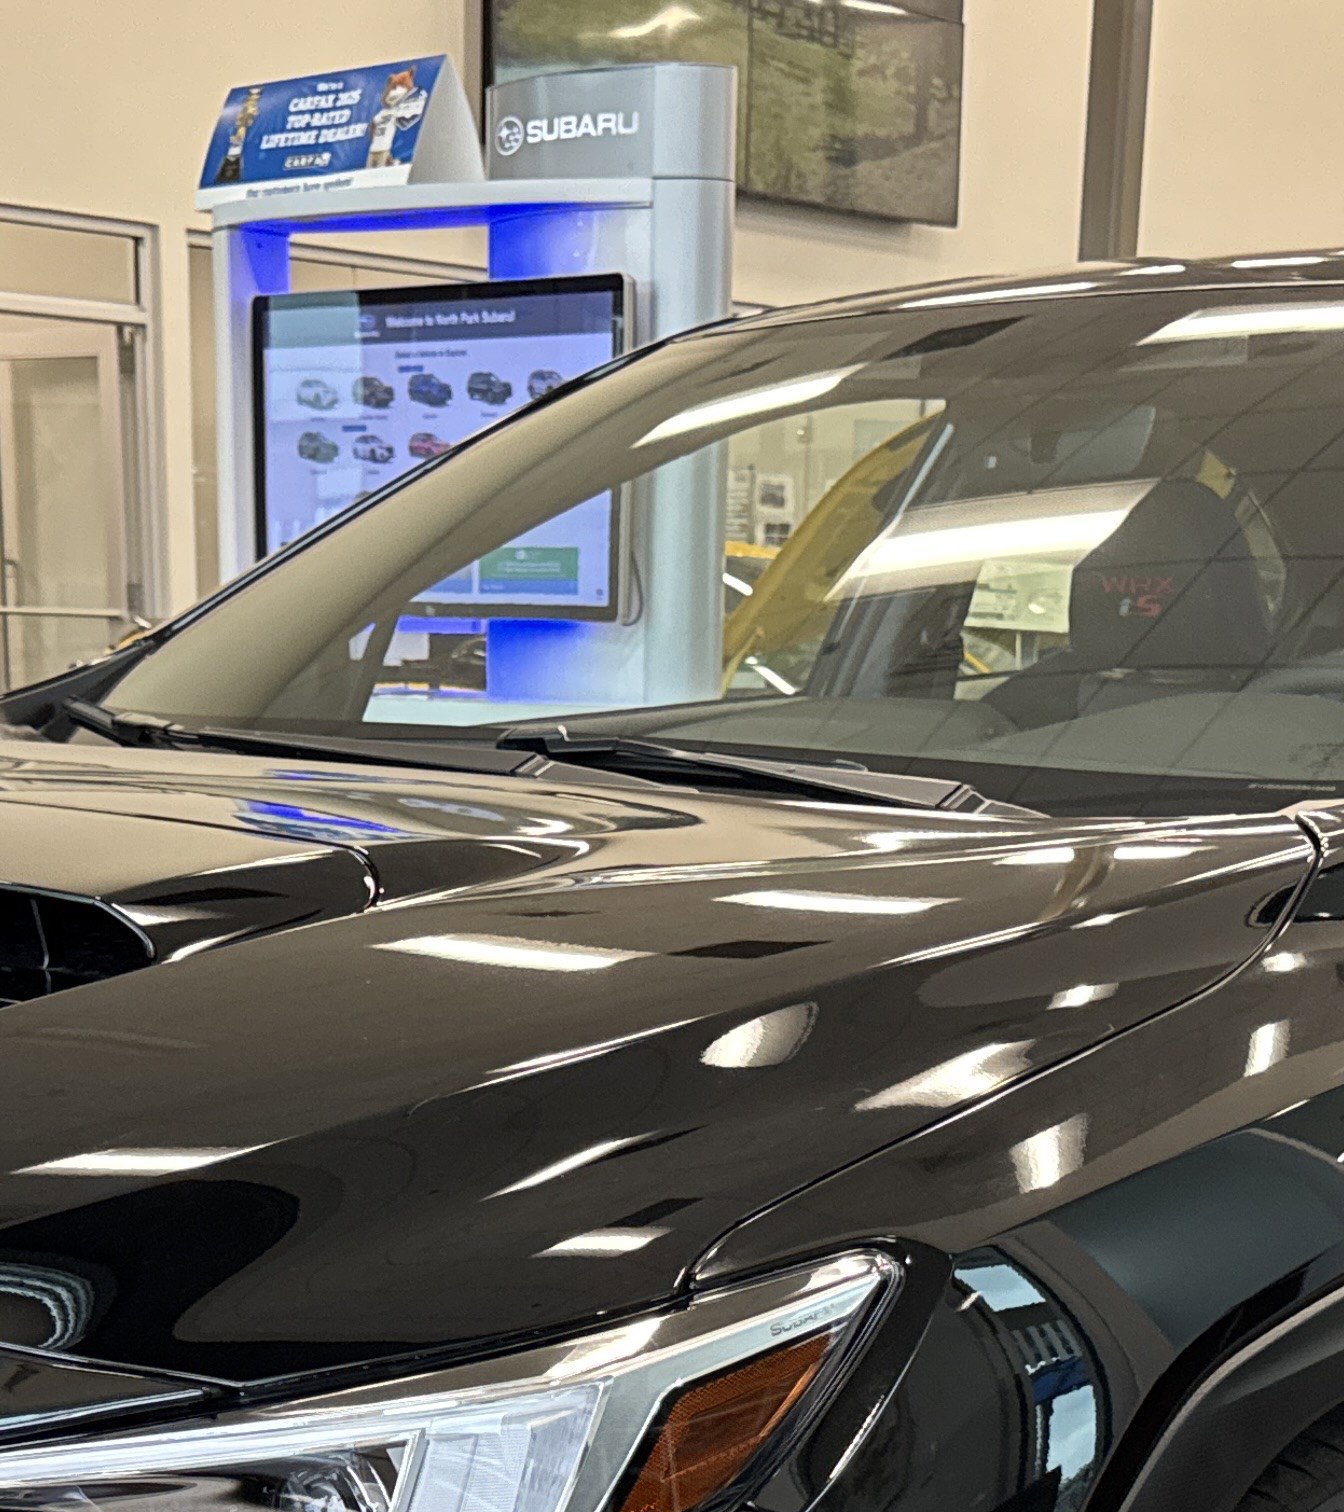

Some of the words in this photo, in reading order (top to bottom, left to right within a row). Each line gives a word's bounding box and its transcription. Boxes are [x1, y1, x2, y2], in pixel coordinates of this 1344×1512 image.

[288, 94, 336, 112] CARFAX
[285, 109, 352, 129] TOP-RATED
[526, 111, 640, 144] SUBARU
[260, 130, 318, 150] LIFETIME
[1100, 576, 1173, 594] WRX
[770, 1303, 836, 1337] SUBA
